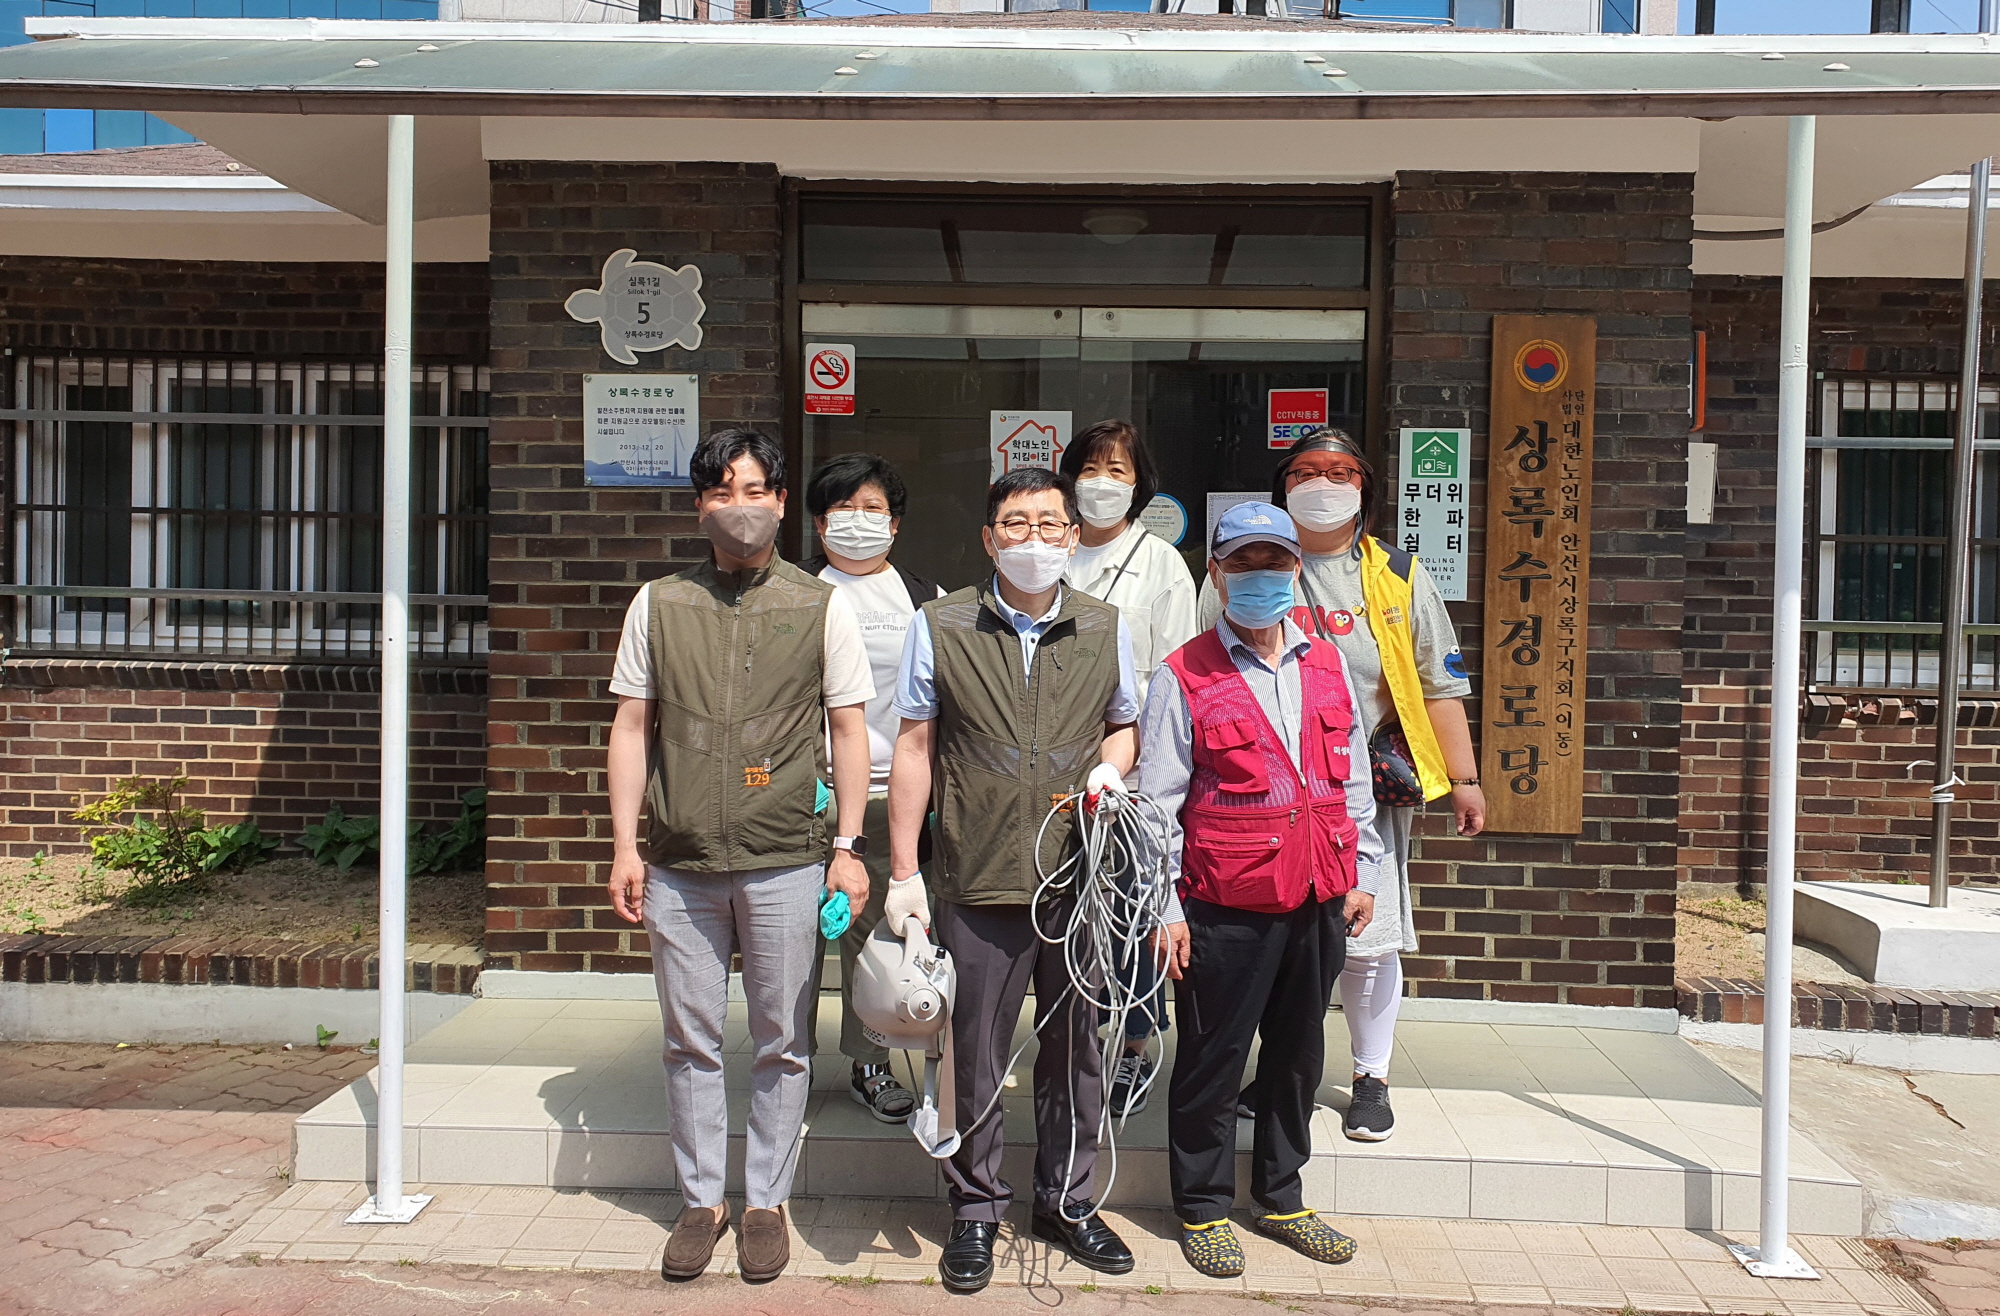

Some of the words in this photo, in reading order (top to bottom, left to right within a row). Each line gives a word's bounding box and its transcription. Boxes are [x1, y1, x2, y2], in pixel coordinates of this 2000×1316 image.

[628, 276, 661, 288] 실록1길
[647, 289, 661, 297] 1-gil
[637, 302, 650, 325] 5
[625, 330, 664, 340] 상록수경로당
[607, 387, 675, 398] 상록수경로당
[1276, 411, 1320, 420] CCTV작동중
[1012, 440, 1050, 450] 학대노인
[1012, 452, 1050, 462] 지킴이집
[1560, 420, 1583, 523] 대한노인회
[1404, 483, 1463, 503] 무더위
[1492, 419, 1558, 796] 상록수경로당
[744, 772, 770, 786] 129
